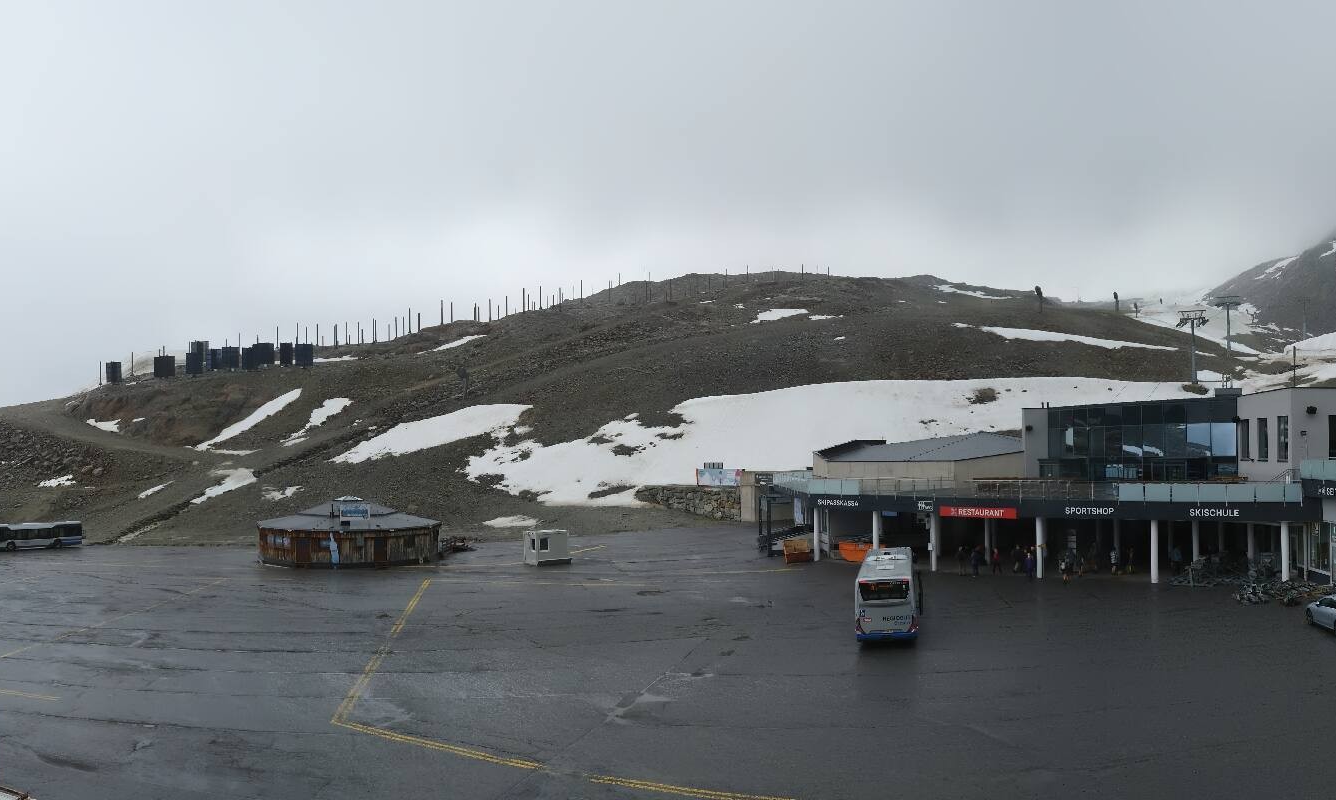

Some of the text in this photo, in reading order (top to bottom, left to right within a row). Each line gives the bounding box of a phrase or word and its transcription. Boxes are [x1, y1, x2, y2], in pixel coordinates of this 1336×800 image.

[817, 498, 859, 507] SKIPASSKASSA
[958, 508, 1005, 517] RESTAURANT
[1065, 506, 1115, 516] SPORTSHOP
[1189, 508, 1240, 517] SKISCHULE
